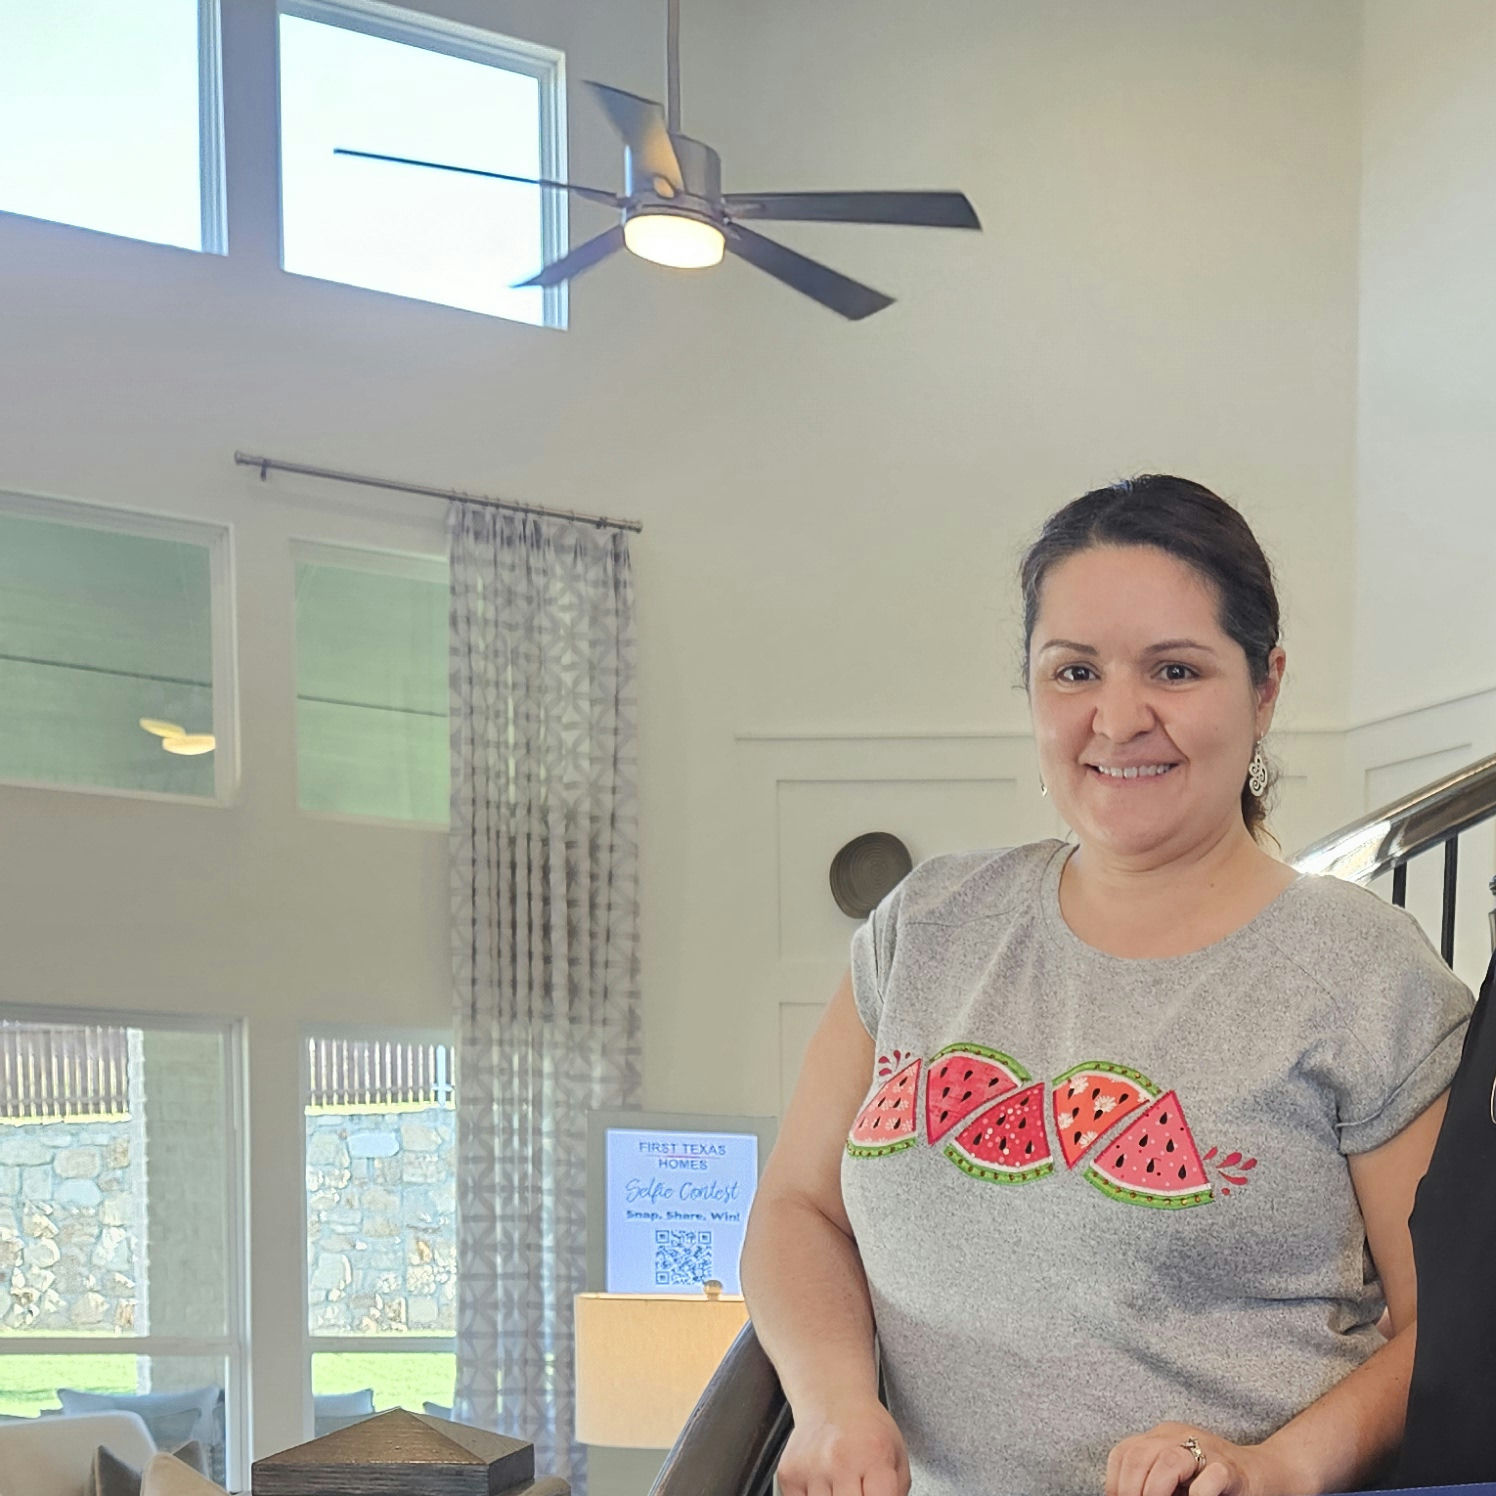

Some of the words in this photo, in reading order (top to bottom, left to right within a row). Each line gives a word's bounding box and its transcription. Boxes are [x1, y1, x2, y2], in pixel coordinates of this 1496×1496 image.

[639, 1141, 677, 1155] FIRST
[682, 1143, 727, 1156] TEXAS
[658, 1158, 708, 1171] HOMES
[625, 1177, 673, 1203] Selfie
[679, 1180, 738, 1204] Contest
[710, 1212, 741, 1222] Win!
